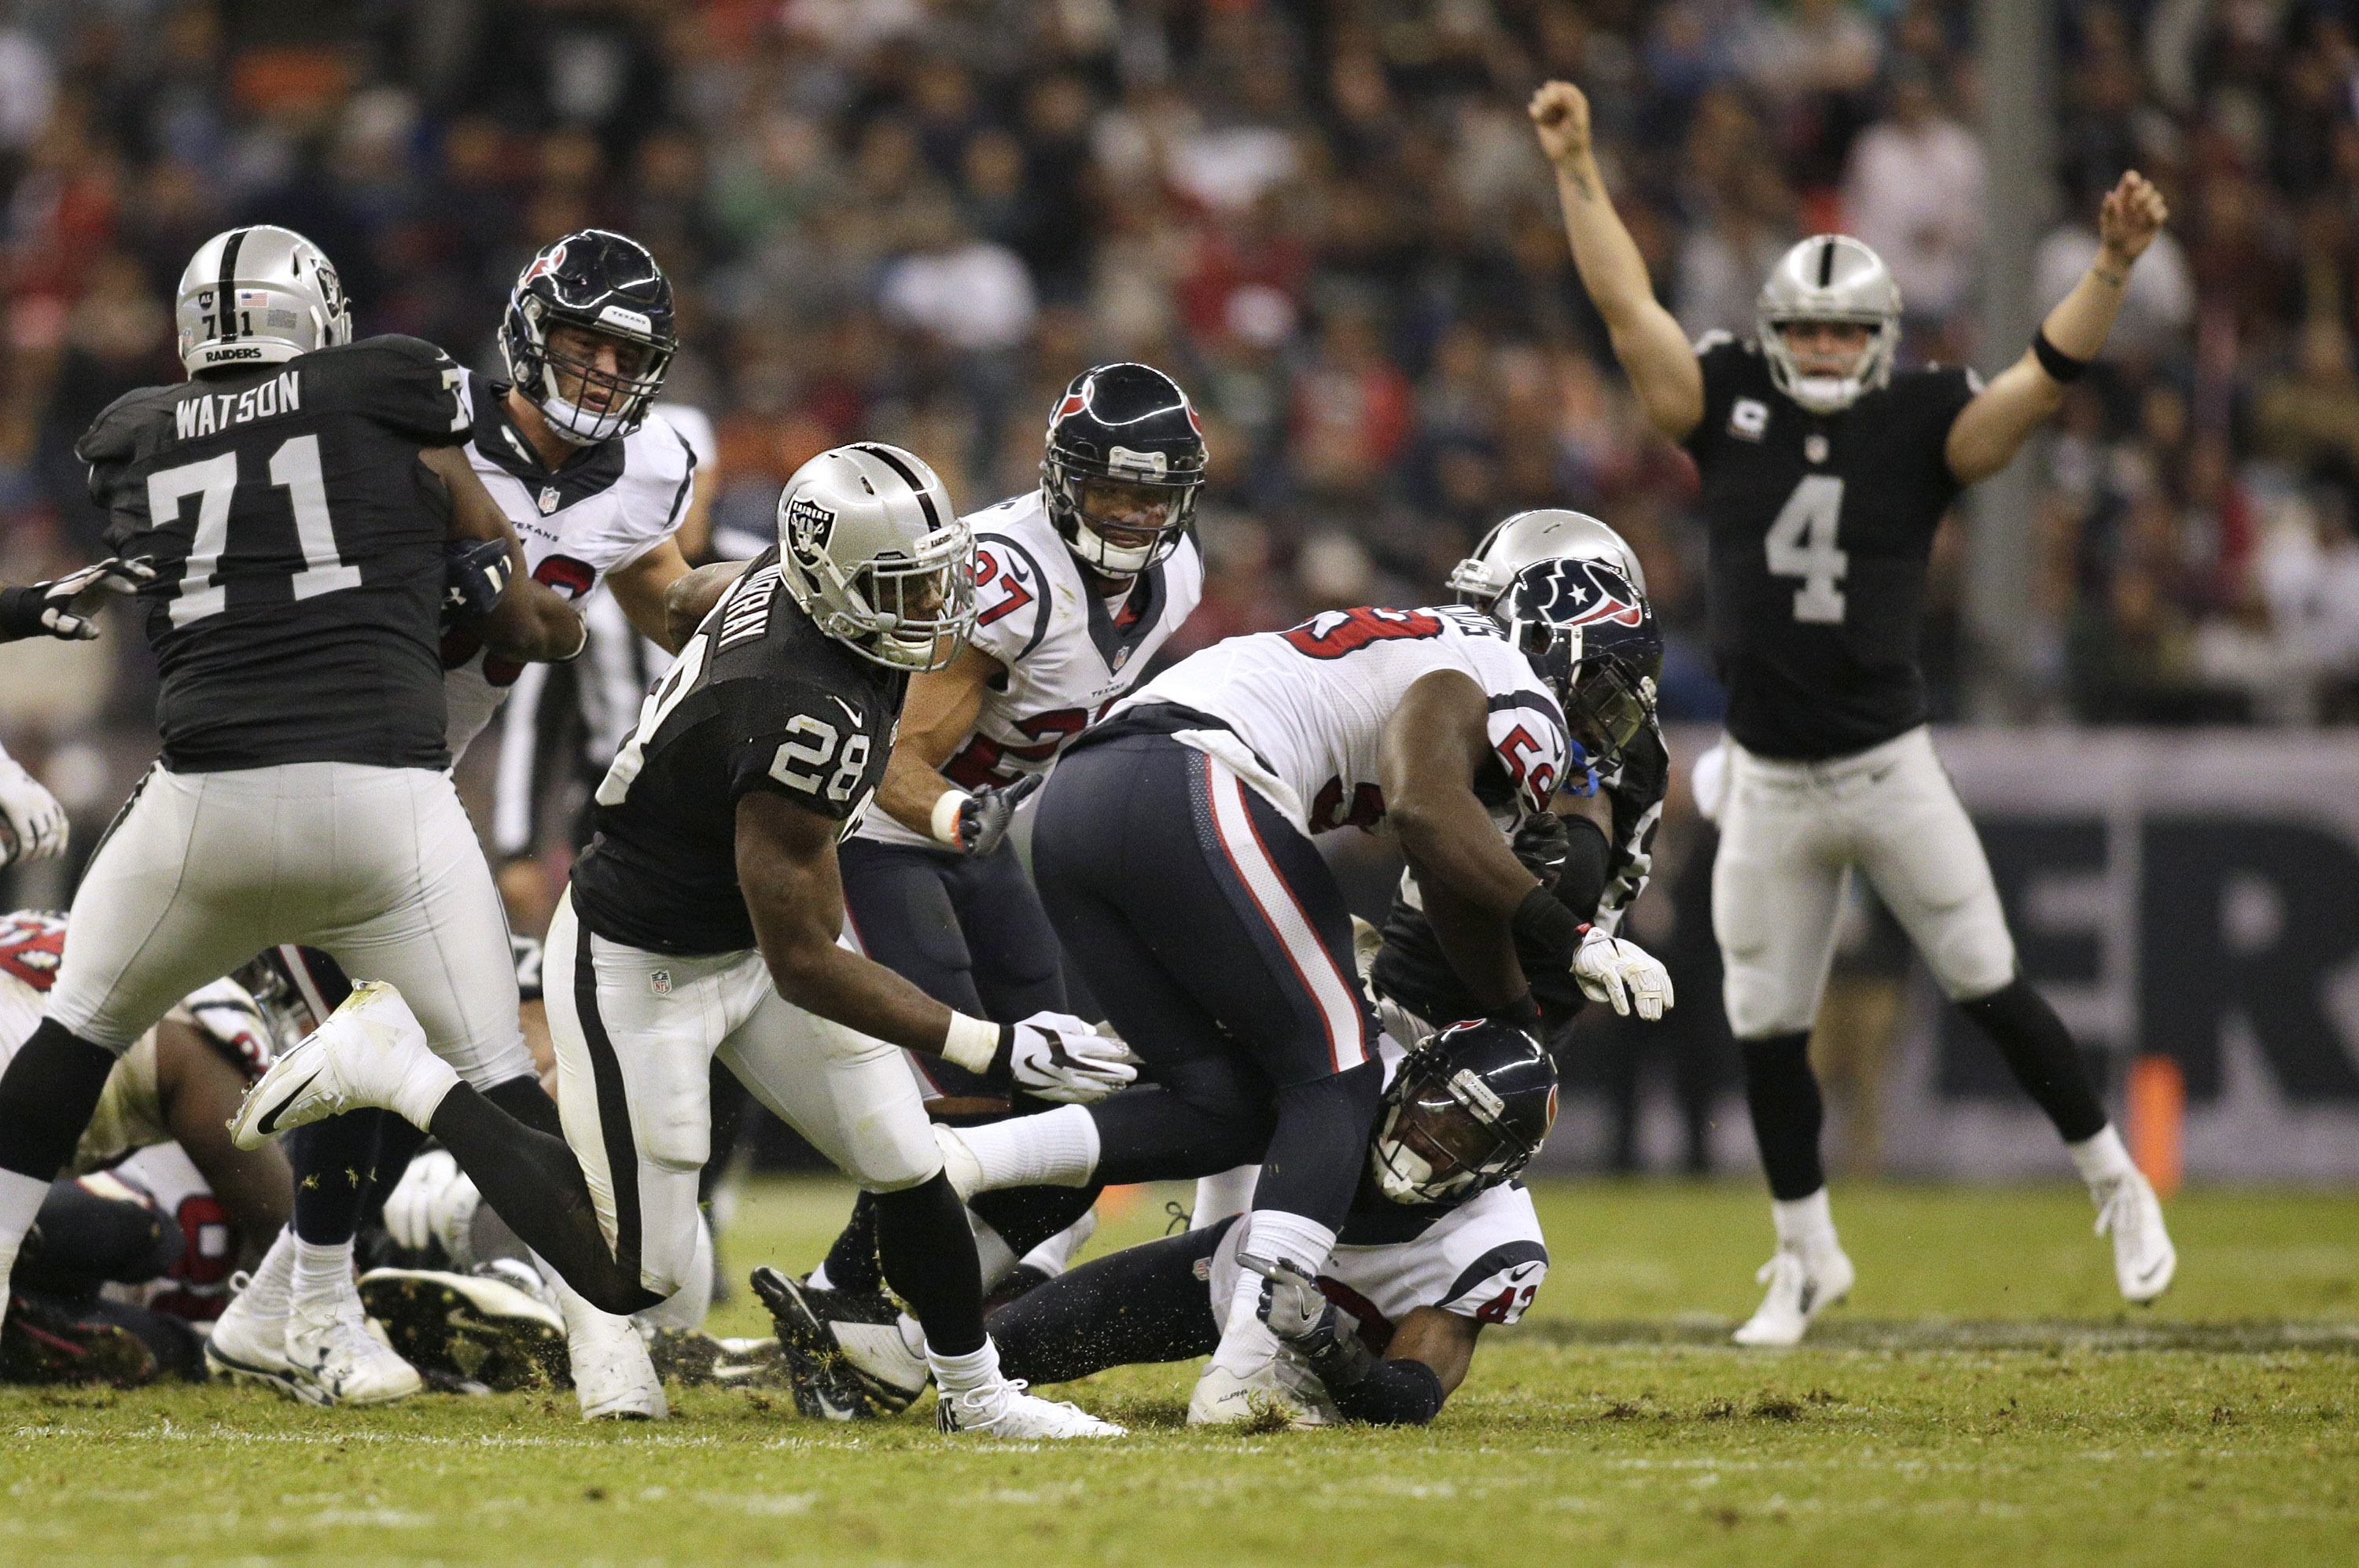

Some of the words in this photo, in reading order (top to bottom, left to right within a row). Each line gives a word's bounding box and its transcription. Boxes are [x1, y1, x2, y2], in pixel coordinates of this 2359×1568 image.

[613, 311, 646, 324] TEXANS
[206, 348, 262, 363] RAIDERS
[177, 371, 299, 440] WATSON
[147, 434, 362, 629] 71
[793, 502, 830, 521] RAIDERS
[1765, 474, 1848, 624] 4
[767, 714, 870, 801] 28
[1495, 723, 1555, 814] 59
[653, 981, 670, 992] NFL
